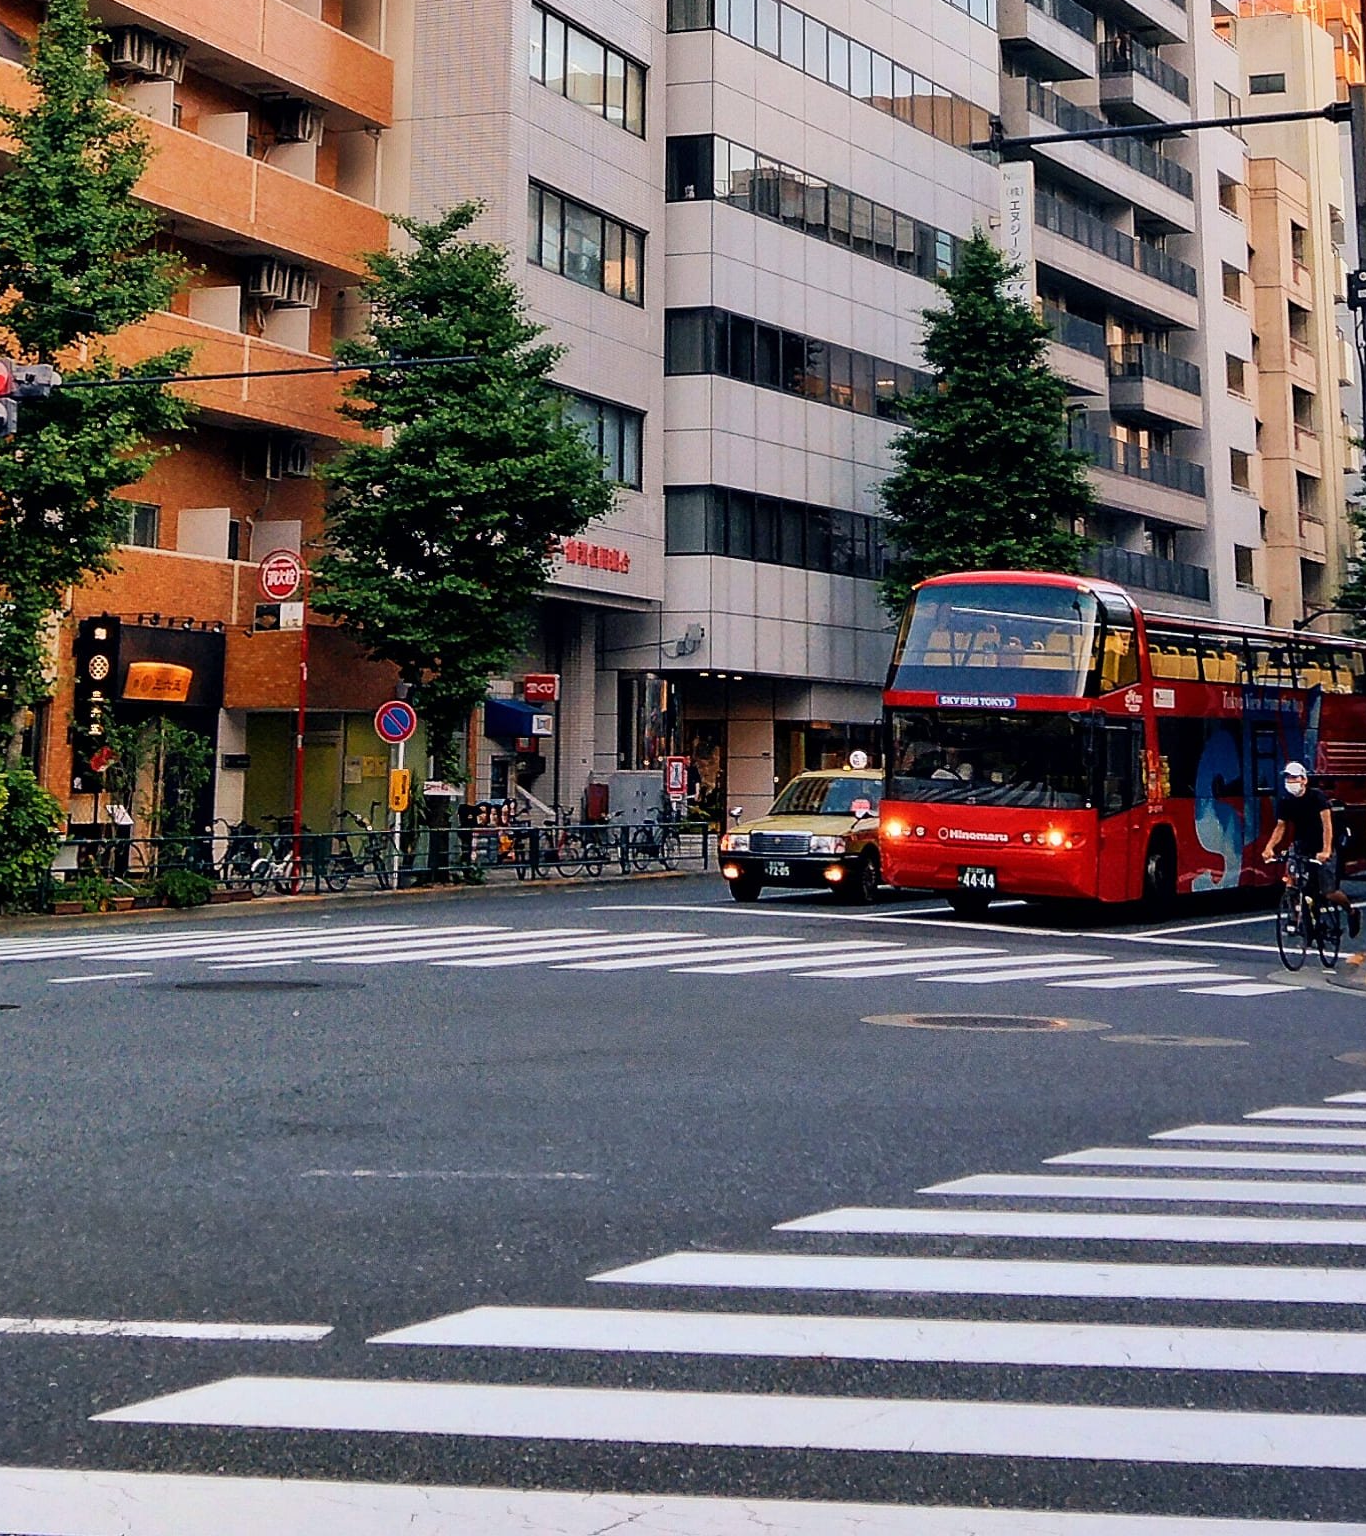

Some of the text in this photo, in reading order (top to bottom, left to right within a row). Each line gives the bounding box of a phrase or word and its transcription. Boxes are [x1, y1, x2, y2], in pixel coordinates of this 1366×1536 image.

[267, 569, 296, 586] 消火栓
[940, 695, 960, 705] SKY
[979, 697, 1012, 707] TOKYO
[949, 829, 1009, 842] Hinomaru
[962, 871, 996, 889] 44-44
